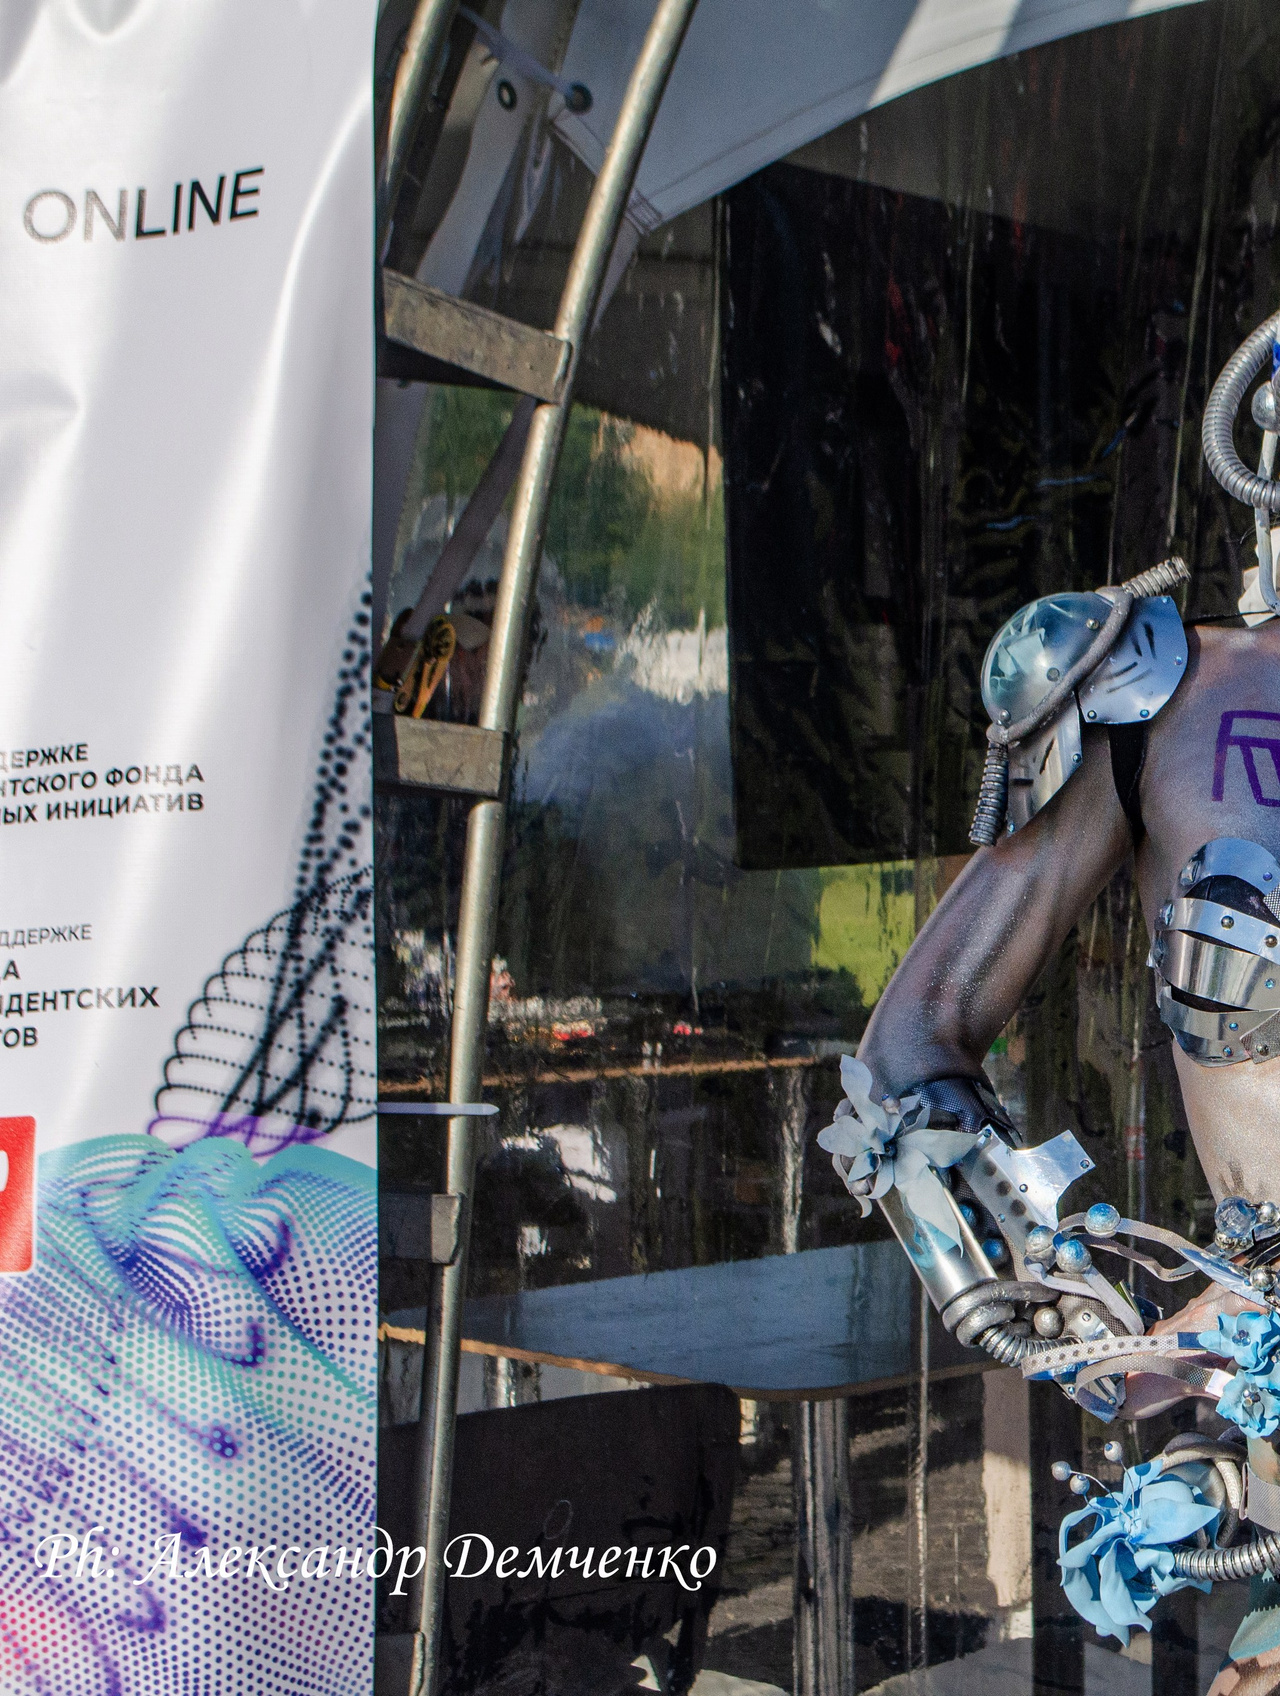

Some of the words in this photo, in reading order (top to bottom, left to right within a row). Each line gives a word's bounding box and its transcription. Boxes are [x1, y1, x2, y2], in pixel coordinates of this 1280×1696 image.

[23, 166, 265, 245] ONLINE
[105, 763, 205, 787] ФОНДА
[0, 803, 38, 826] ЫХ
[47, 793, 205, 820] ИНИЦИАТИВ
[0, 959, 21, 984] А
[0, 986, 160, 1018] ДЕНТСКИХ
[0, 1026, 39, 1048] ОВ
